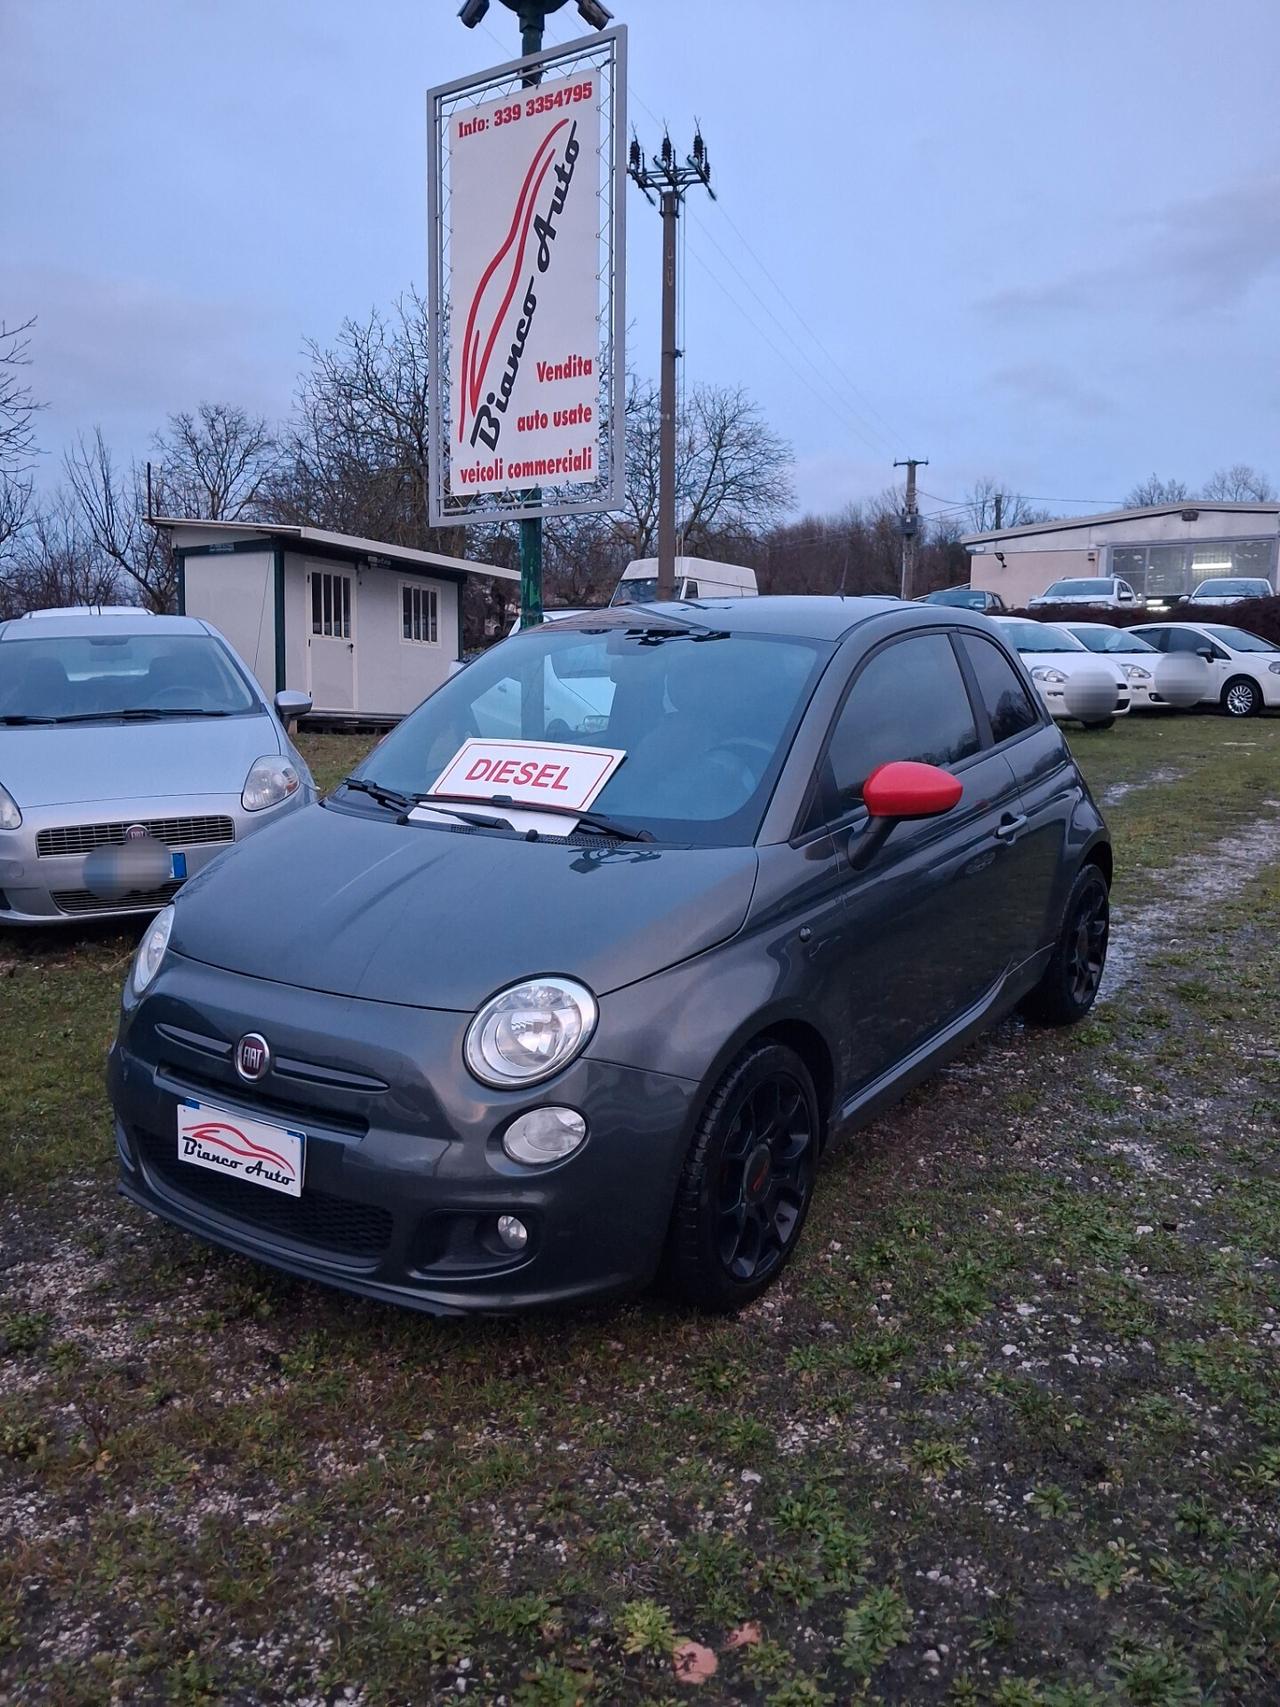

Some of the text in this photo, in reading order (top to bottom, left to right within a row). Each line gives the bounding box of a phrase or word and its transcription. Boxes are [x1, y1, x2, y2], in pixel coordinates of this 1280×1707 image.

[458, 81, 593, 138] Info: 339 3354795
[470, 119, 580, 452] Bianco Auto
[536, 354, 592, 383] Vendita
[517, 403, 592, 432] auto usate
[460, 446, 592, 484] veicoli commerciali
[465, 758, 570, 790] DIESEL
[242, 1046, 263, 1069] FIAT
[182, 1136, 296, 1185] Bianco Auto
